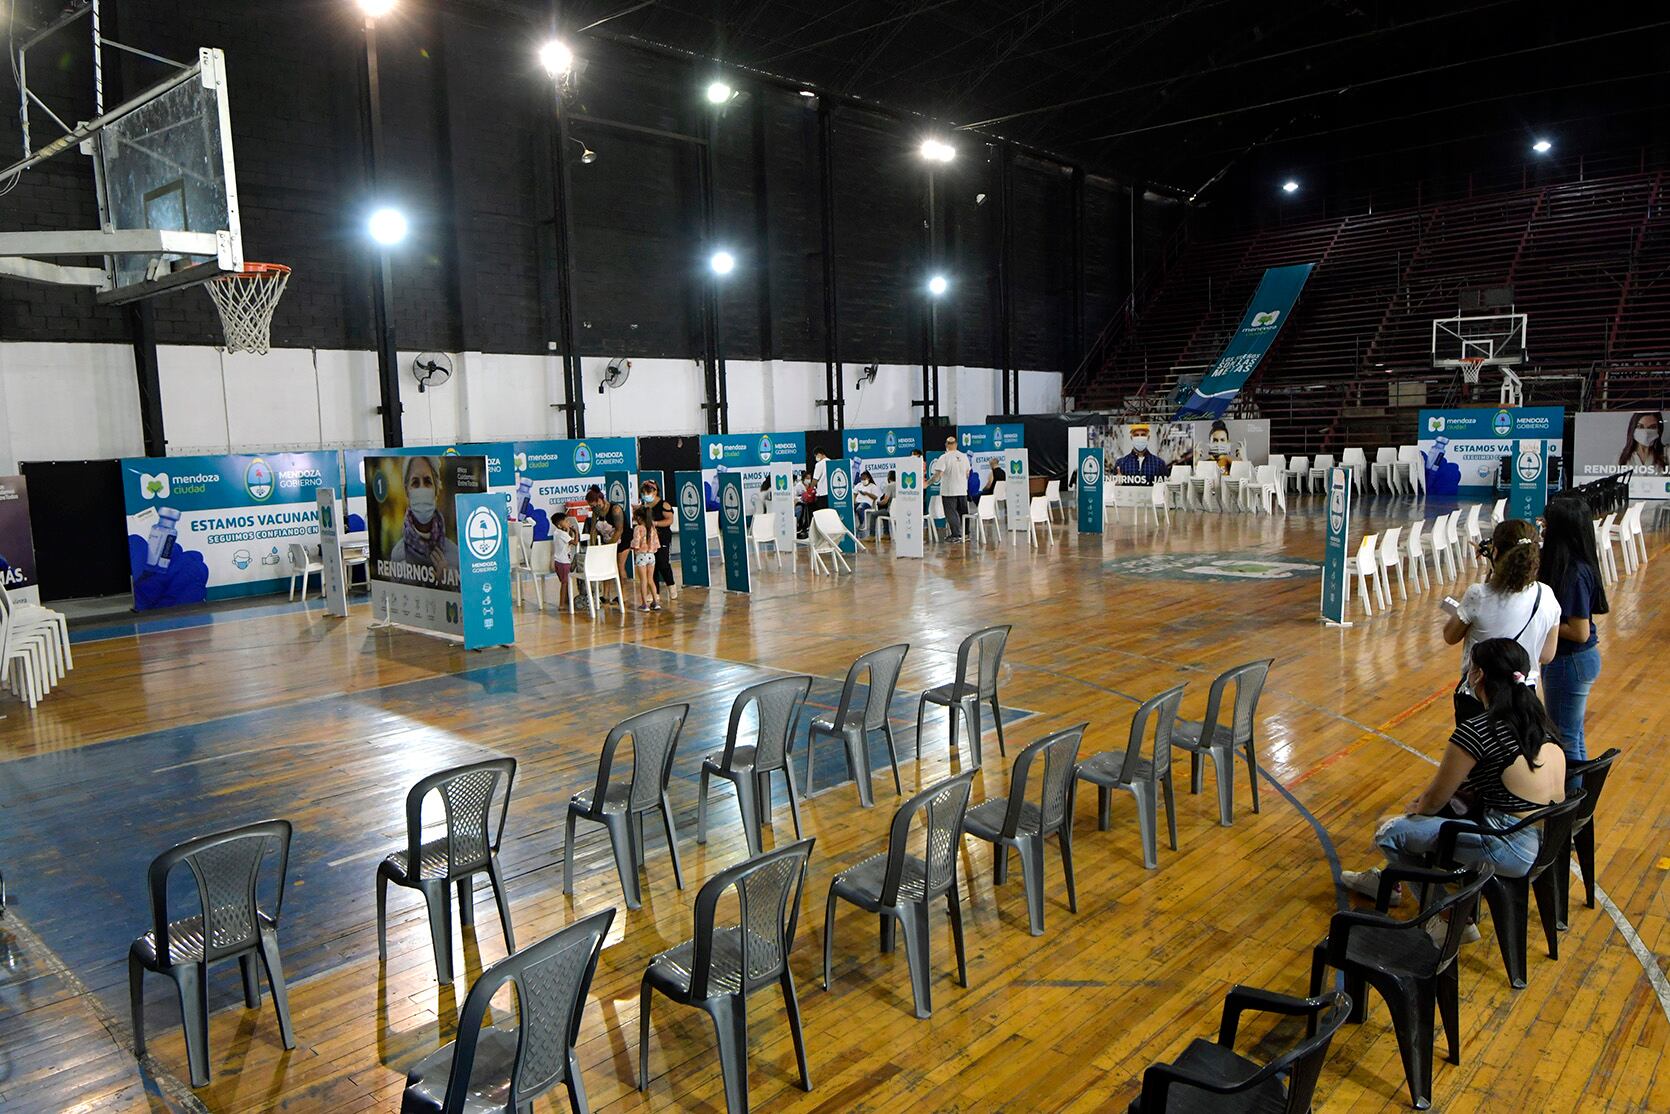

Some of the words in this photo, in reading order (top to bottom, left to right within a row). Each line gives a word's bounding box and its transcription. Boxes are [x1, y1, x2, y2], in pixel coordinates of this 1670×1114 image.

[1453, 444, 1495, 453] ESTAMOS
[527, 453, 558, 461] mendoza
[595, 451, 624, 459] MENDOZA
[528, 461, 549, 469] ciudad
[595, 458, 624, 466] GOBIERNO
[864, 463, 889, 471] ESTAMOS
[1584, 464, 1658, 475] RENDIRNOS,
[172, 473, 220, 485] mendoza
[278, 469, 322, 480] MENDOZA
[173, 484, 206, 495] ciudad
[279, 477, 323, 488] GOBIERNO
[376, 482, 382, 496] 1
[539, 484, 580, 496] ESTAMOS
[190, 515, 255, 532] ESTAMOS
[207, 531, 254, 545] SEGUIMOS
[255, 526, 305, 539] CONFIANDO
[307, 525, 319, 534] EN
[377, 559, 439, 586] RENDIRNOS,
